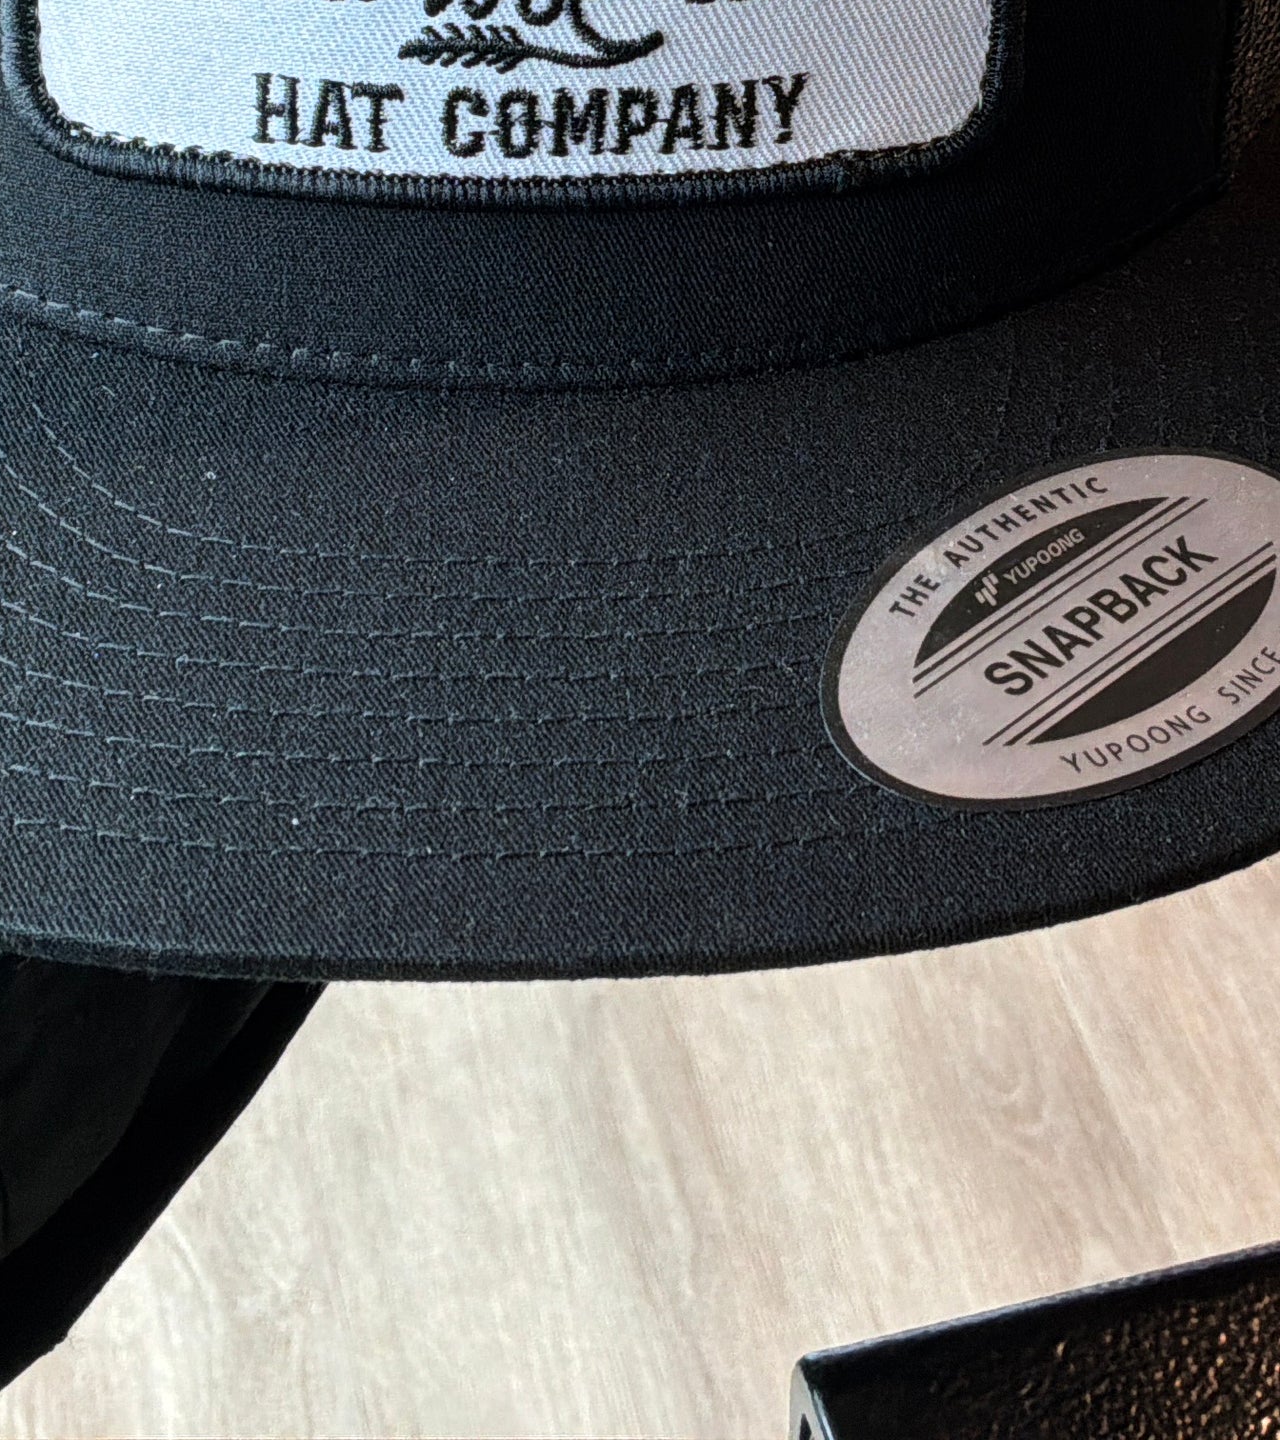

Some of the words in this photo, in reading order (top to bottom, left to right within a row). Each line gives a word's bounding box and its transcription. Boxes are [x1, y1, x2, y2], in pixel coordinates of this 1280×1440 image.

[252, 72, 405, 153] HAT
[440, 72, 810, 160] COMPANY
[888, 573, 940, 620] THE
[944, 476, 1108, 569] AUTHENTIC
[1001, 526, 1086, 585] YUPOONG
[983, 535, 1219, 697] SNAPBACK
[1059, 705, 1213, 775] YUPOONG
